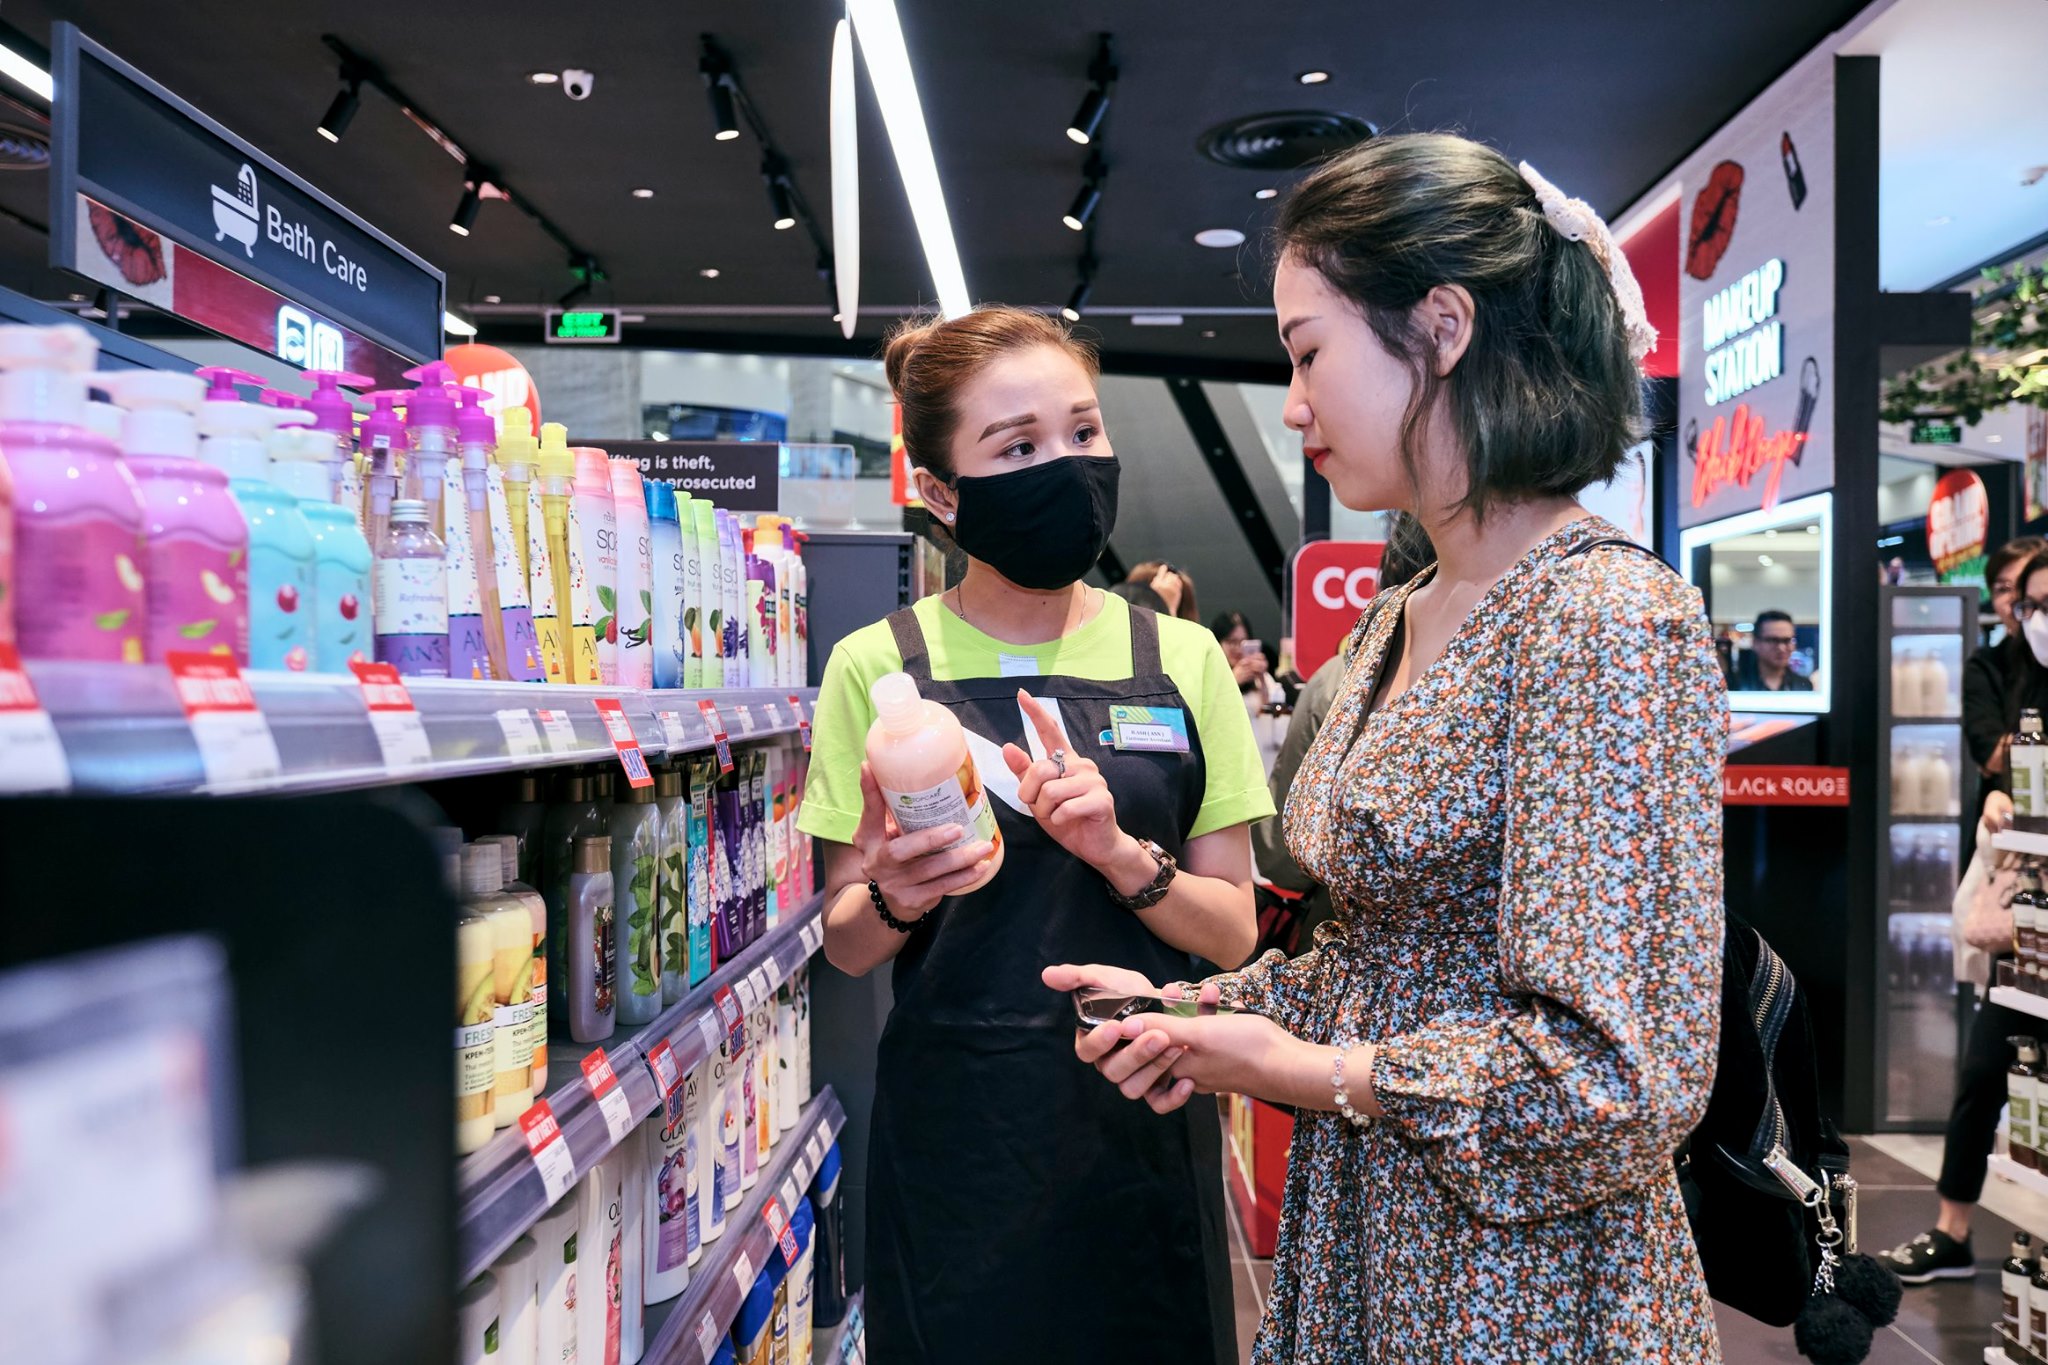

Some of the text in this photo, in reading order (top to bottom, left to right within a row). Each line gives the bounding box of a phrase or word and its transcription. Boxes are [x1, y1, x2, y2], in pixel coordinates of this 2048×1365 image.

[267, 204, 367, 292] Bath Care
[1703, 258, 1782, 352] MAKEUP
[1704, 320, 1780, 407] STATION
[655, 455, 668, 470] is
[672, 455, 715, 472] theft,
[620, 748, 649, 780] SAVE
[1724, 777, 1778, 797] LACK
[465, 1029, 494, 1045] FRES
